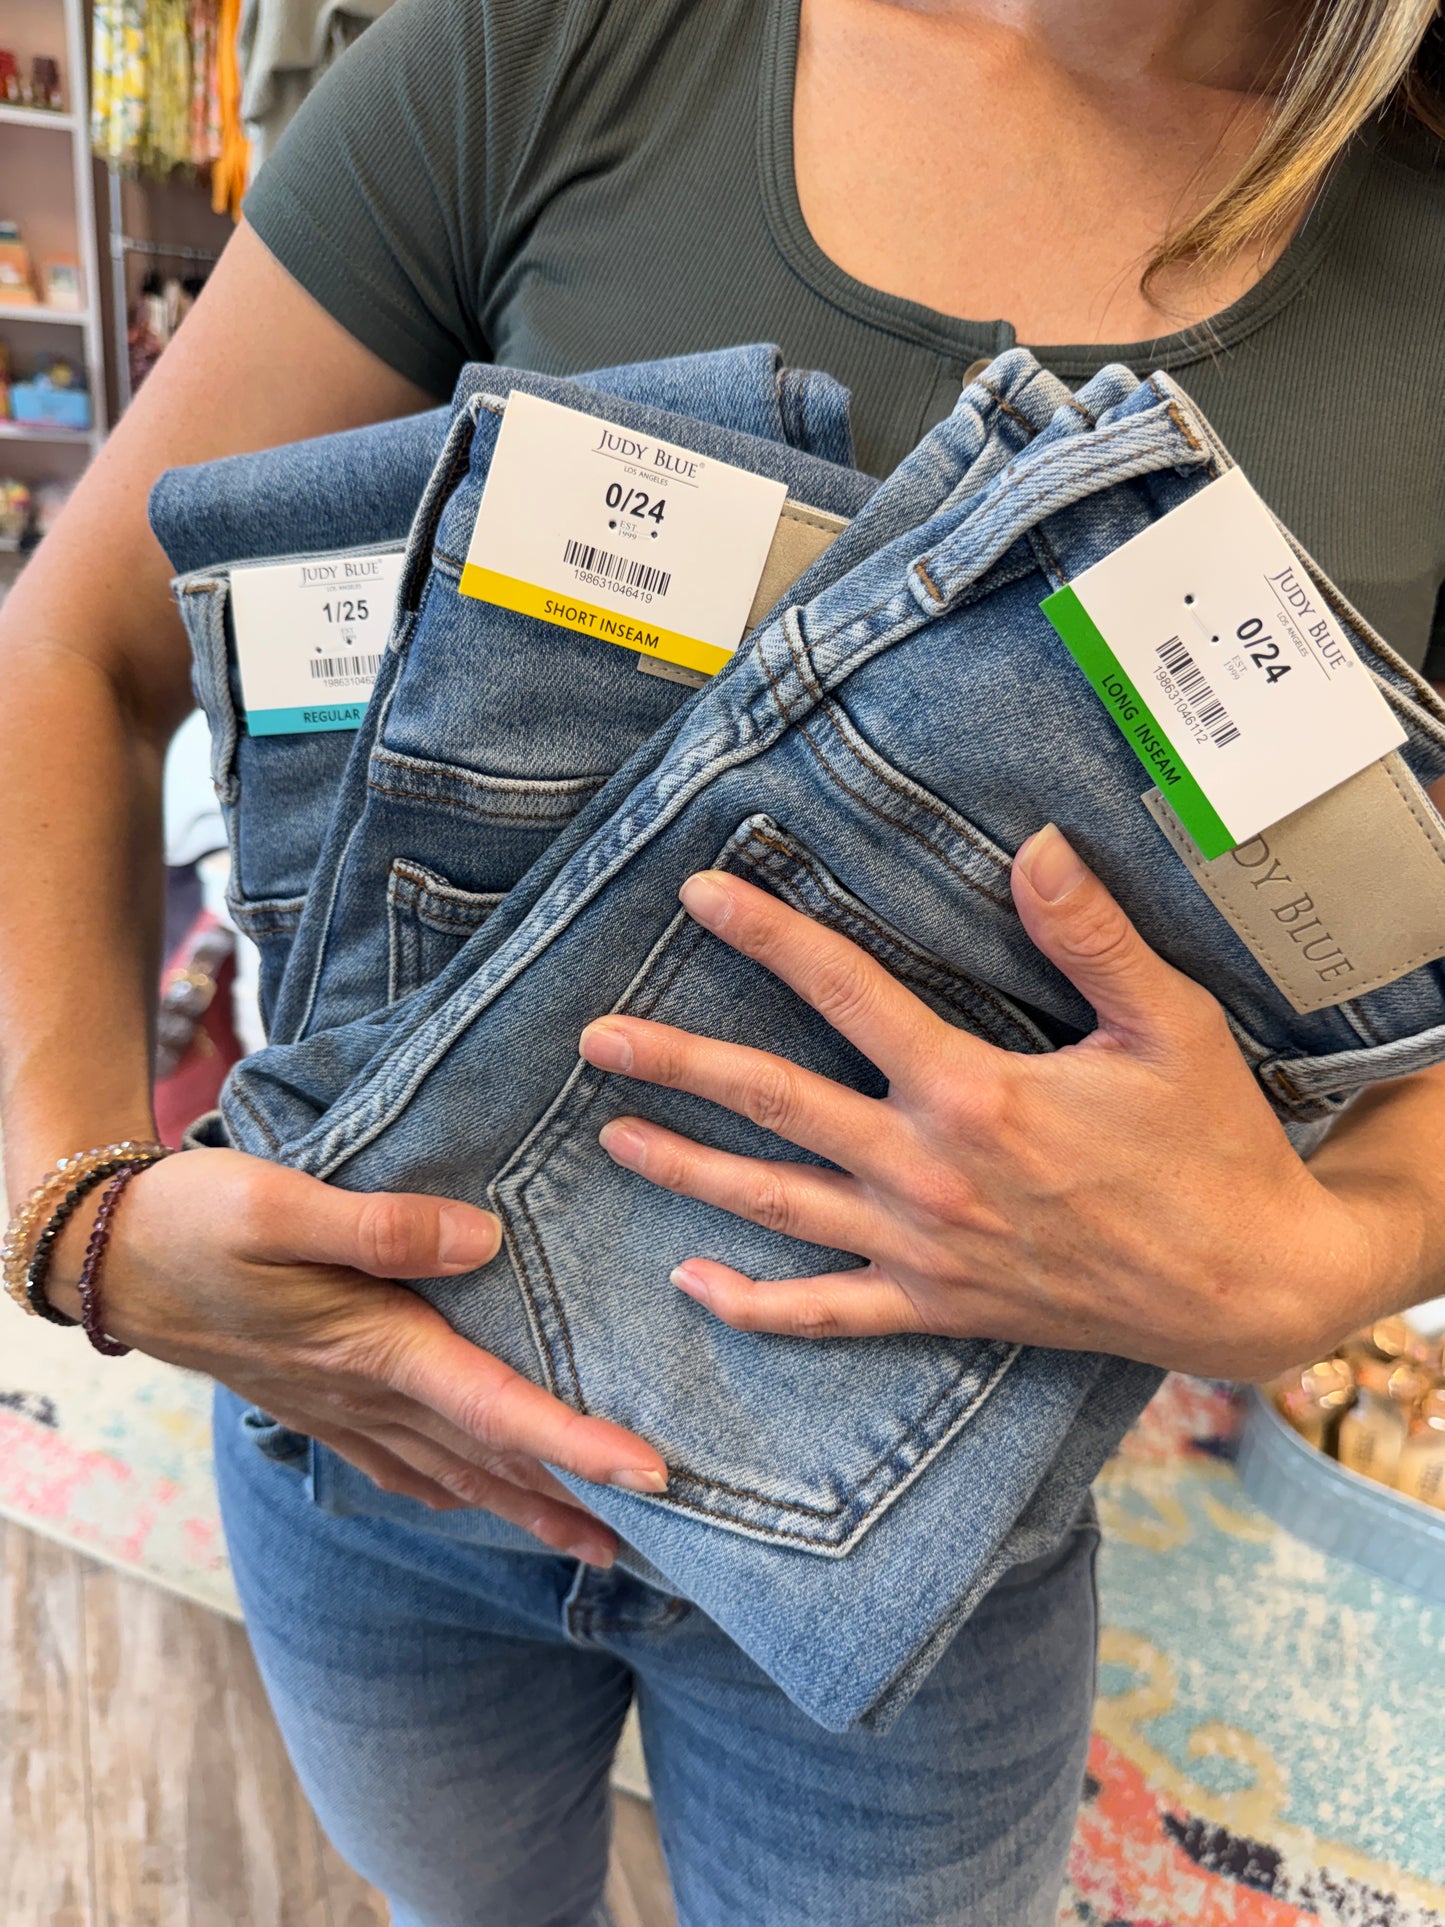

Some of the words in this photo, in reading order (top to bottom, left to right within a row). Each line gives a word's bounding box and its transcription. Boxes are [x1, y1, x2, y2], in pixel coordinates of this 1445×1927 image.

[597, 429, 648, 460] JUDY
[624, 465, 637, 475] LOS
[639, 471, 668, 486] ANGELES
[605, 482, 666, 524] 0/24
[302, 566, 338, 585] JUDY
[574, 569, 653, 604] 198631046419
[1270, 565, 1316, 618] JUDY
[323, 599, 369, 623] 1/25
[544, 600, 598, 628] SHORT
[599, 618, 660, 649] INSEAM
[1236, 617, 1292, 684] 0/24
[1276, 611, 1289, 627] LOS
[1286, 623, 1309, 658] ANGELES
[323, 675, 376, 688] 1986310462
[303, 708, 361, 724] REGULAR
[1152, 665, 1208, 745] 198631046112
[1101, 673, 1139, 721] LONG
[1133, 723, 1182, 786] INSEAM
[1231, 833, 1292, 891] DY
[1270, 892, 1355, 982] BLUE
